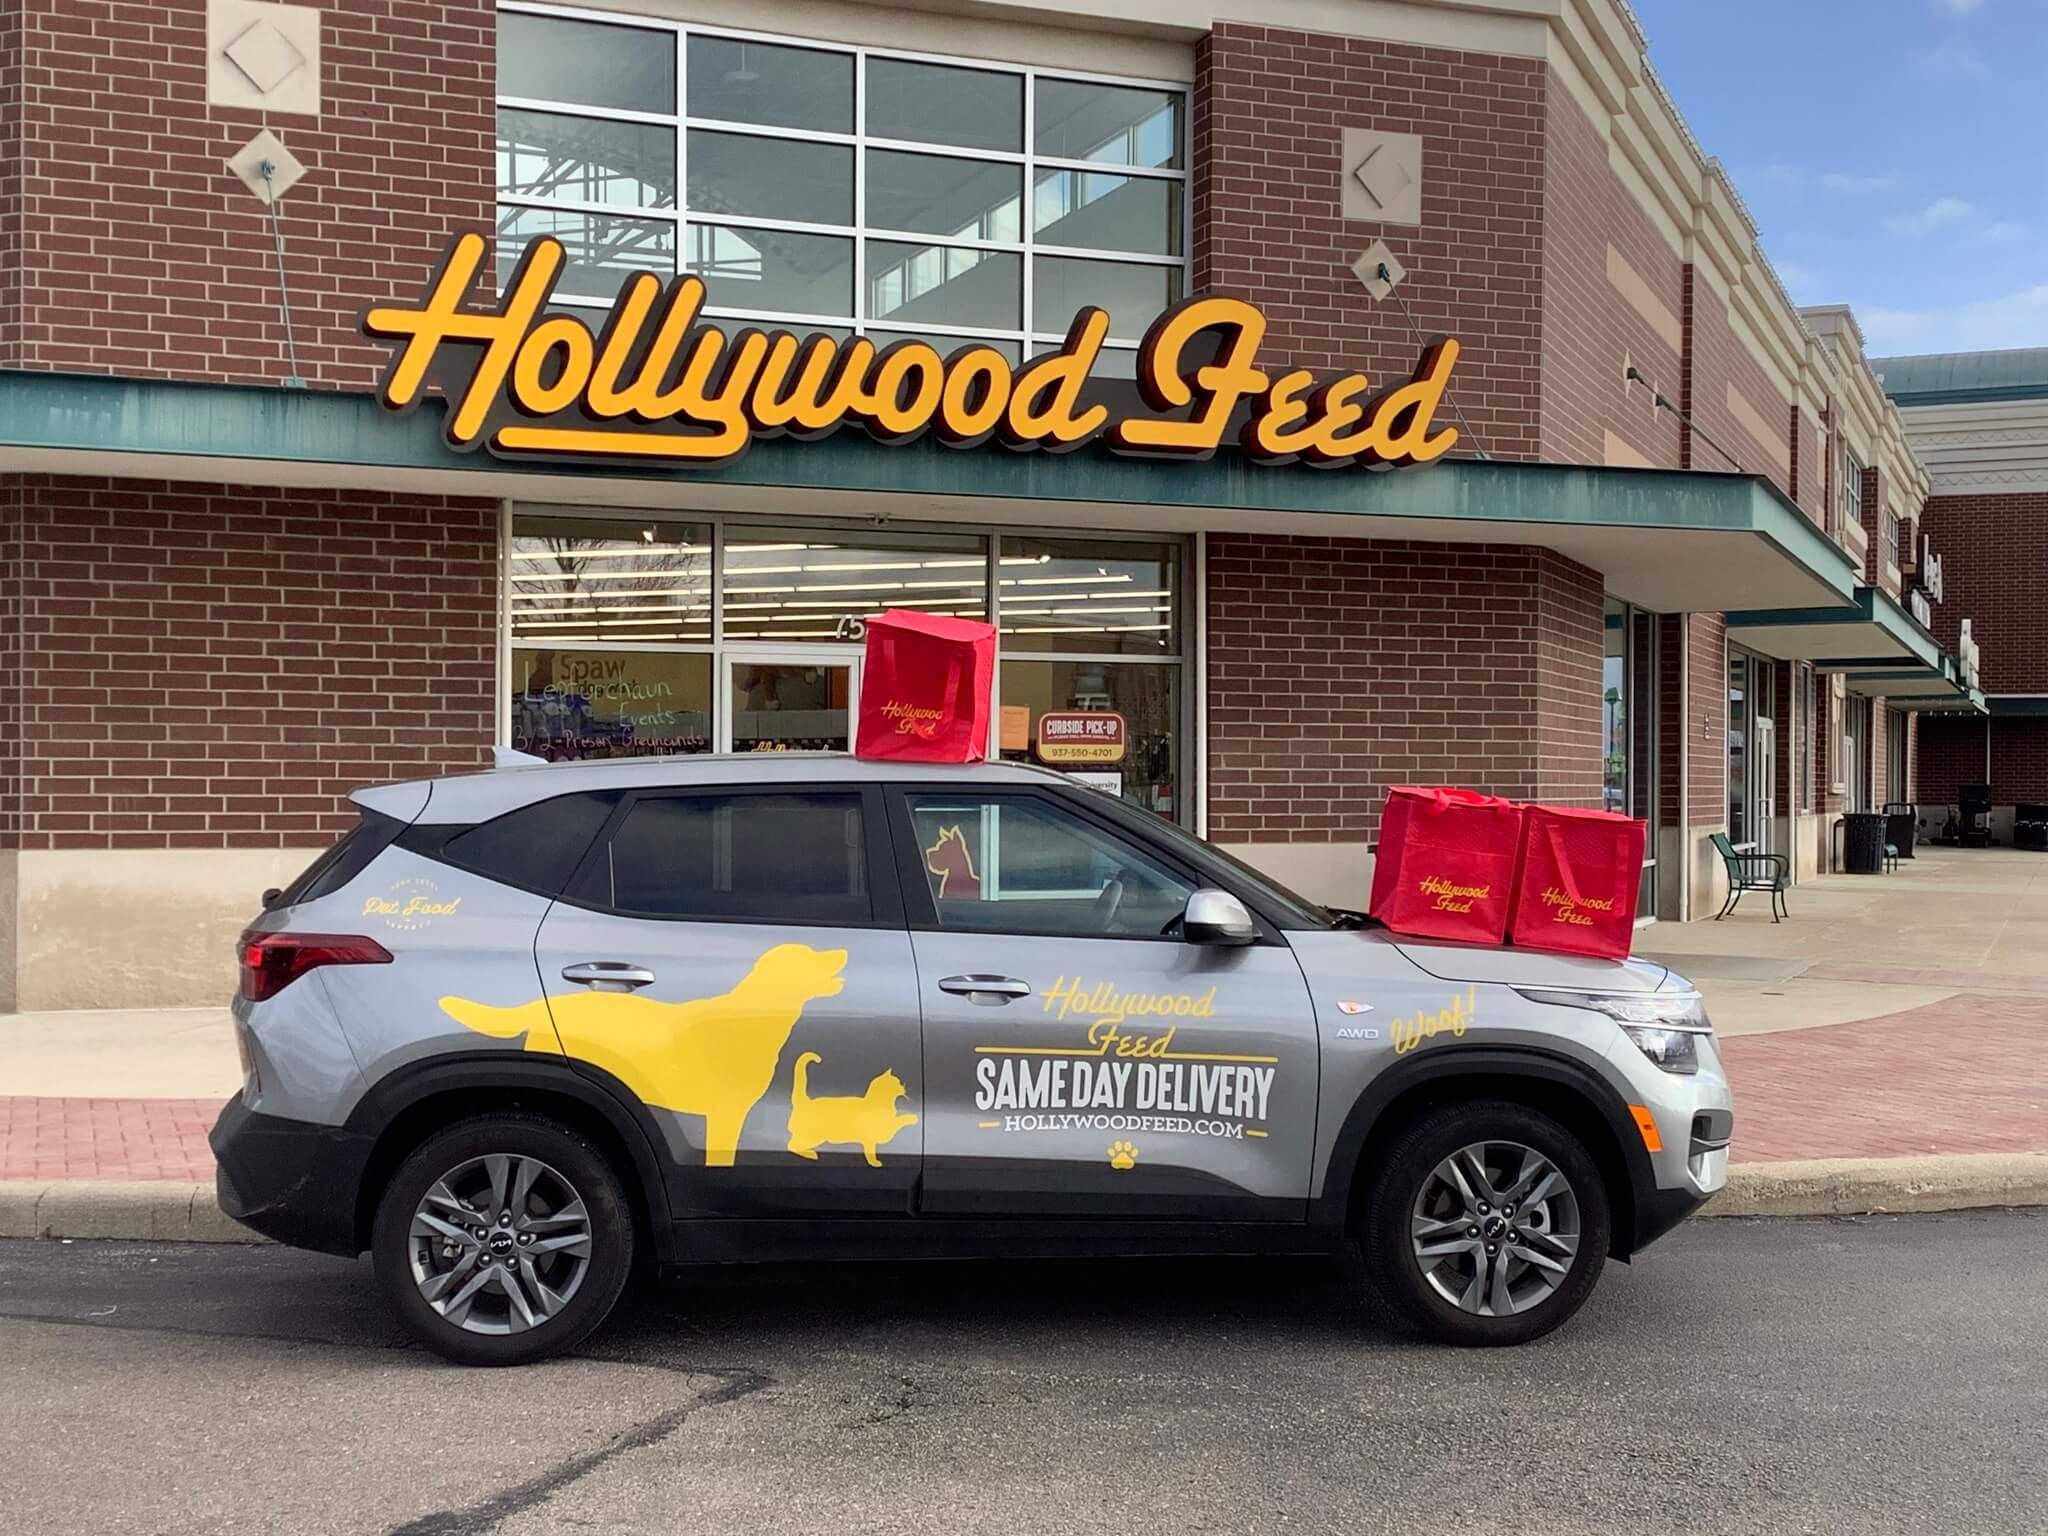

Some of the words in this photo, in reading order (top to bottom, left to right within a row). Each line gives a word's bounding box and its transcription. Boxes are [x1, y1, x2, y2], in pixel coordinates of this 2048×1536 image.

[364, 232, 1108, 458] Hollywood
[1119, 298, 1460, 462] Feed
[620, 701, 677, 727] Events
[880, 700, 944, 721] Hollywoo
[1047, 720, 1084, 734] CURBSIDE
[1086, 720, 1118, 735] PICK-UP
[1052, 748, 1112, 757] 937-550-4701
[1419, 876, 1490, 898] Hollywood
[1432, 895, 1474, 913] Feed
[1040, 976, 1218, 1021] Hollywood
[1389, 985, 1476, 1055] Woof!
[1088, 1017, 1177, 1058] Feed
[1336, 1027, 1379, 1039] AWD
[975, 1058, 1068, 1111] SAME
[1071, 1061, 1133, 1109] DAY
[1135, 1063, 1276, 1120] DELIVERY
[1004, 1115, 1244, 1139] HOLLYWOODFEED.COM
